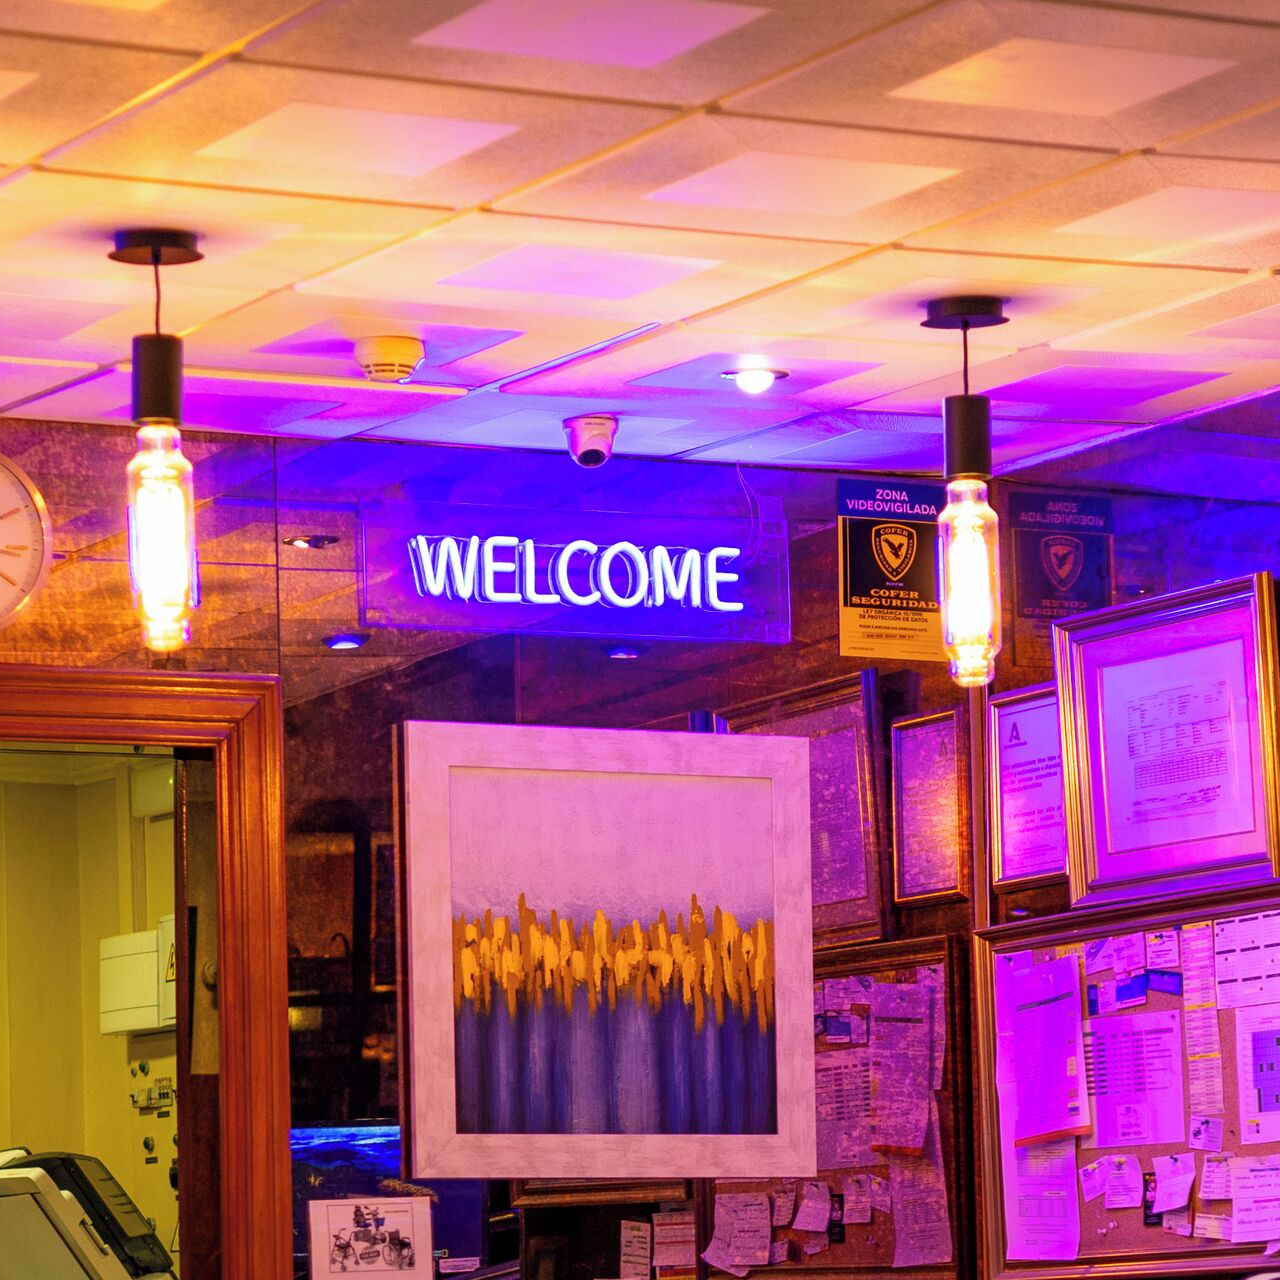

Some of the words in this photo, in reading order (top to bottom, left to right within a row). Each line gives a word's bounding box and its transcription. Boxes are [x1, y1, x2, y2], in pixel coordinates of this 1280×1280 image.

[876, 489, 908, 501] ZONA
[847, 499, 937, 516] VIDEOVIGILADA
[880, 528, 909, 538] COFER
[408, 535, 744, 612] WELCOME
[870, 588, 919, 599] COFER
[851, 596, 939, 609] SEGURIDAD
